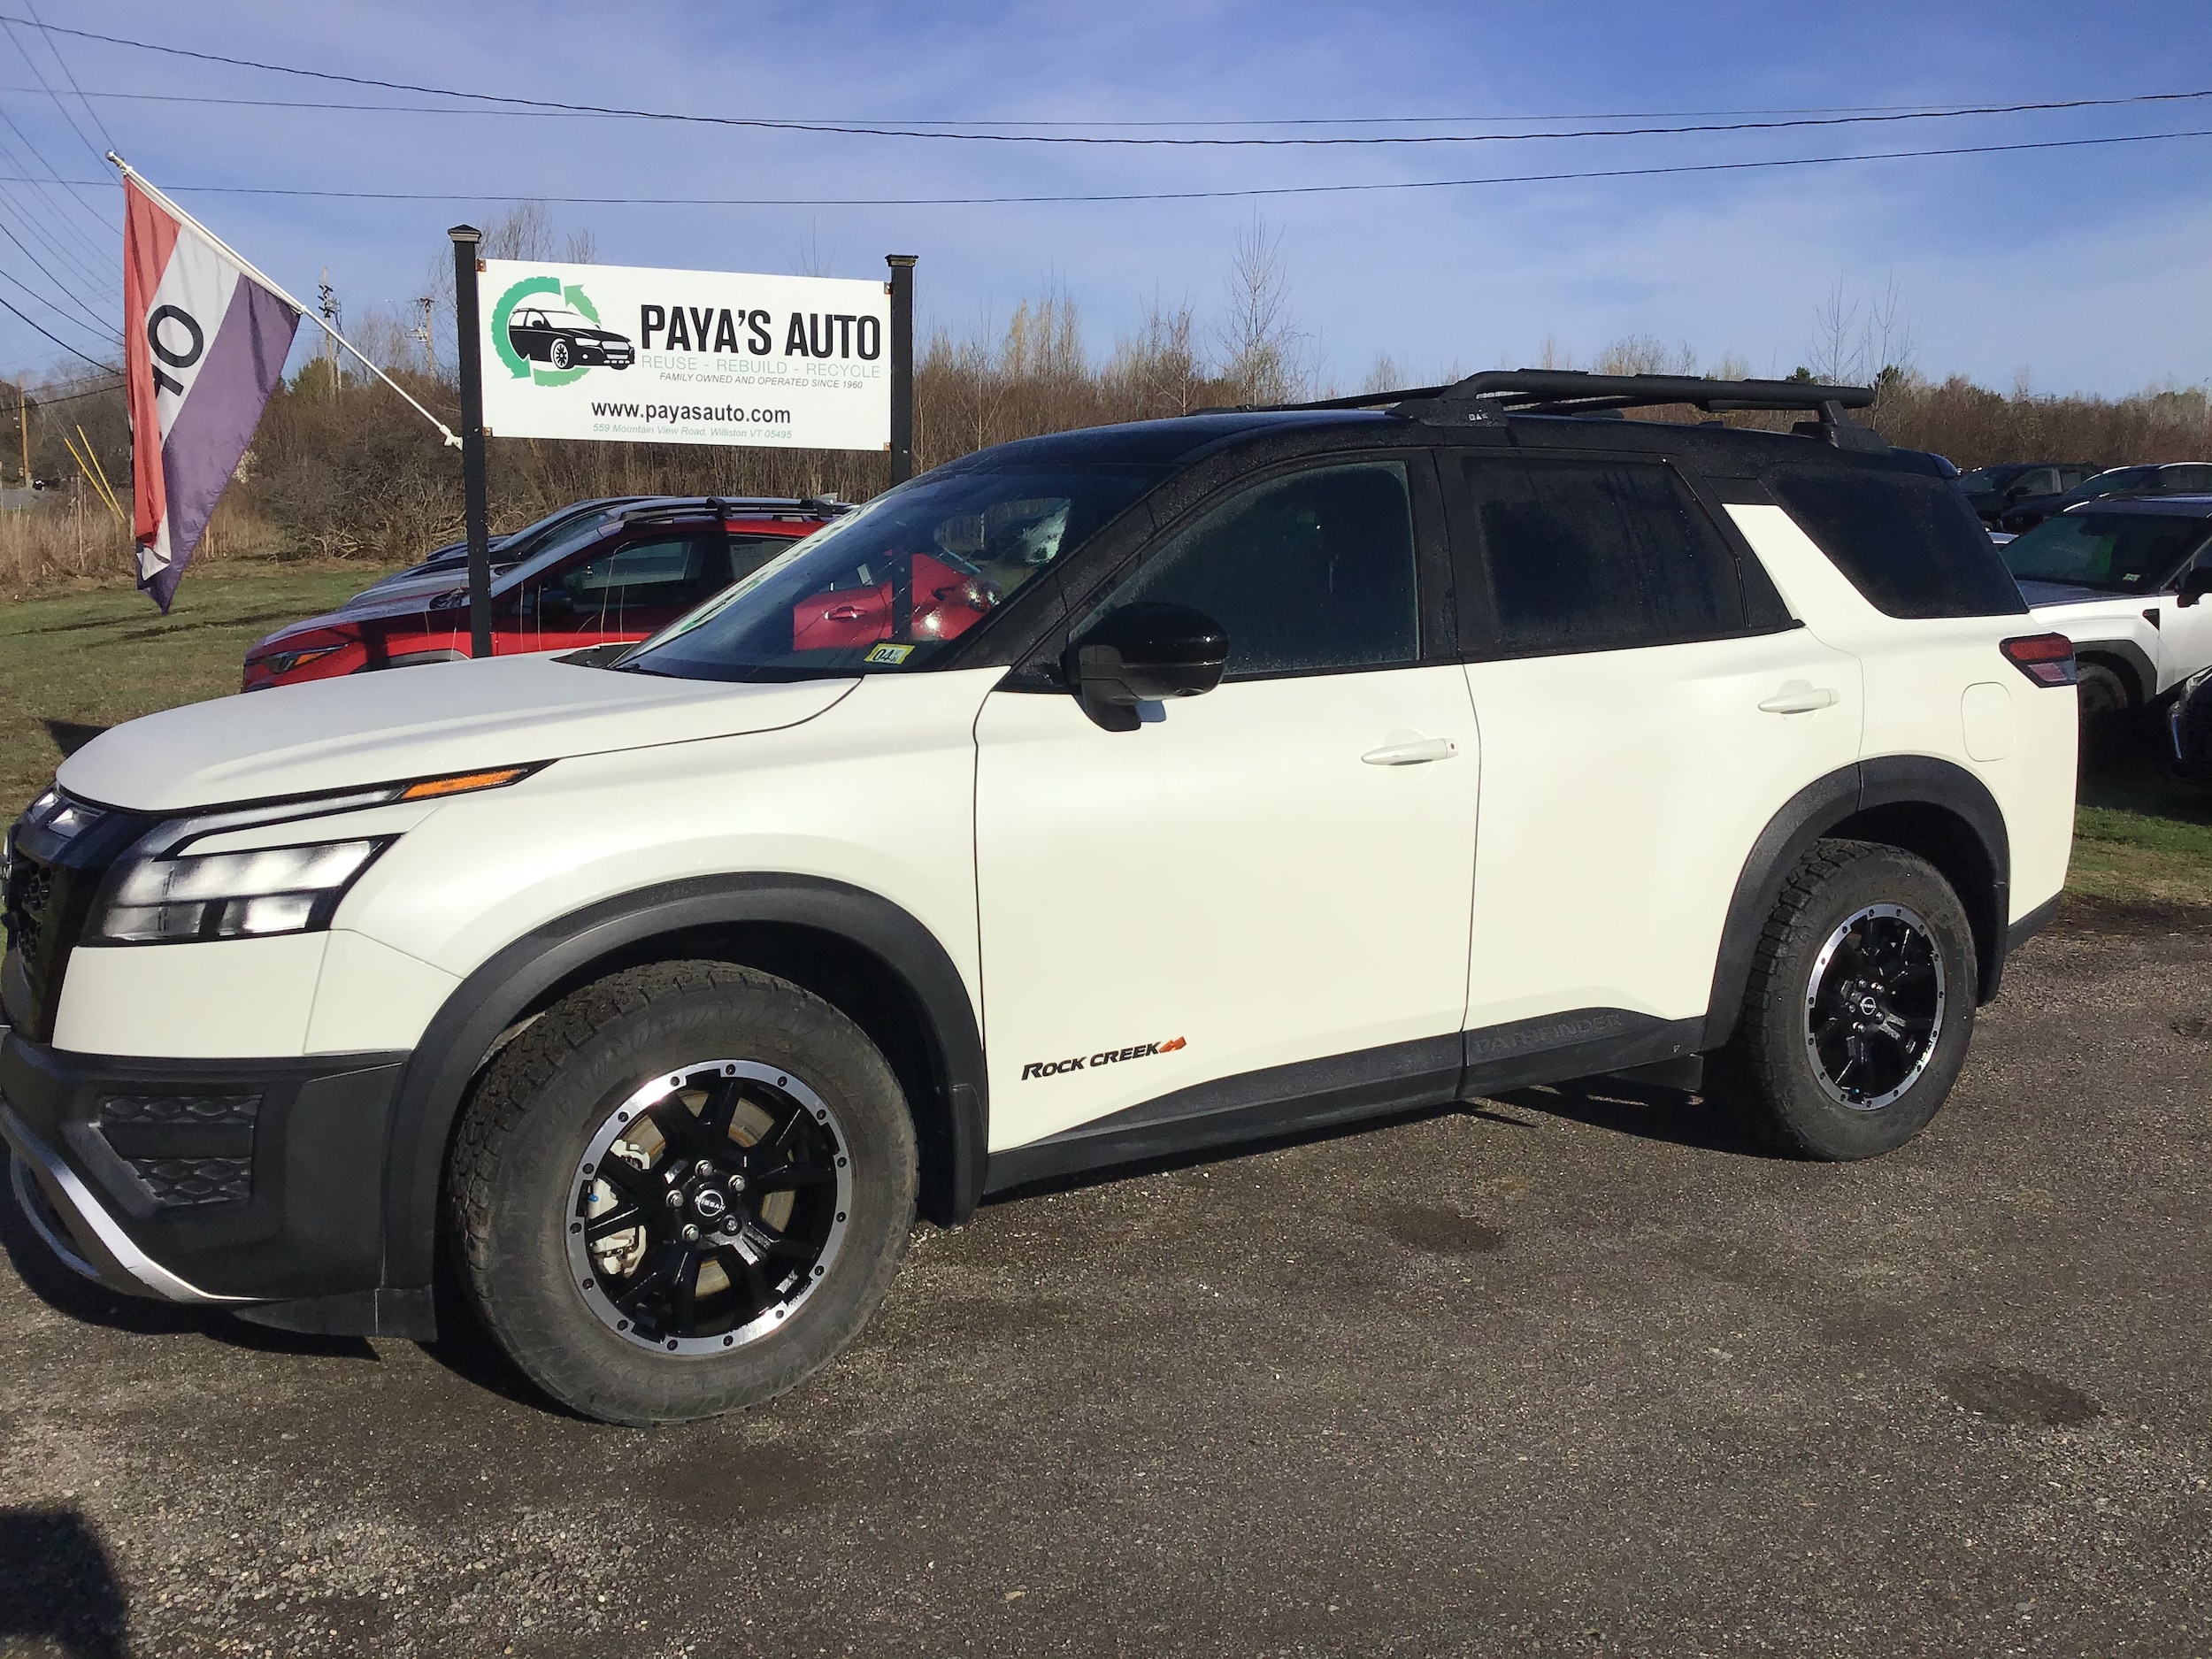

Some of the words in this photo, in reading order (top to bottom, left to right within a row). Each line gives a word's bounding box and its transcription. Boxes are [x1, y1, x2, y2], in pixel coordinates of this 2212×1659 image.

[641, 304, 772, 356] PAYA'S
[784, 312, 880, 361] AUTO
[641, 355, 697, 371] REUSE
[716, 358, 787, 375] REBUILD
[806, 363, 880, 379] RECYCLE
[659, 372, 694, 382] FAMILY
[695, 373, 733, 384] OWNED
[734, 375, 756, 385] AND
[757, 376, 809, 388] OPERATED
[810, 379, 840, 388] SINCE
[841, 380, 864, 389] 1960
[591, 401, 791, 425] www.payasauto.com
[592, 423, 611, 433] 559
[612, 424, 655, 434] Mountain
[657, 426, 680, 435] View
[710, 427, 748, 438] Williston
[749, 429, 763, 438] VT
[764, 430, 793, 440] 05495
[1021, 1056, 1087, 1081] ROCK
[1090, 1041, 1161, 1067] CREEK
[695, 1195, 726, 1211] NISSAN
